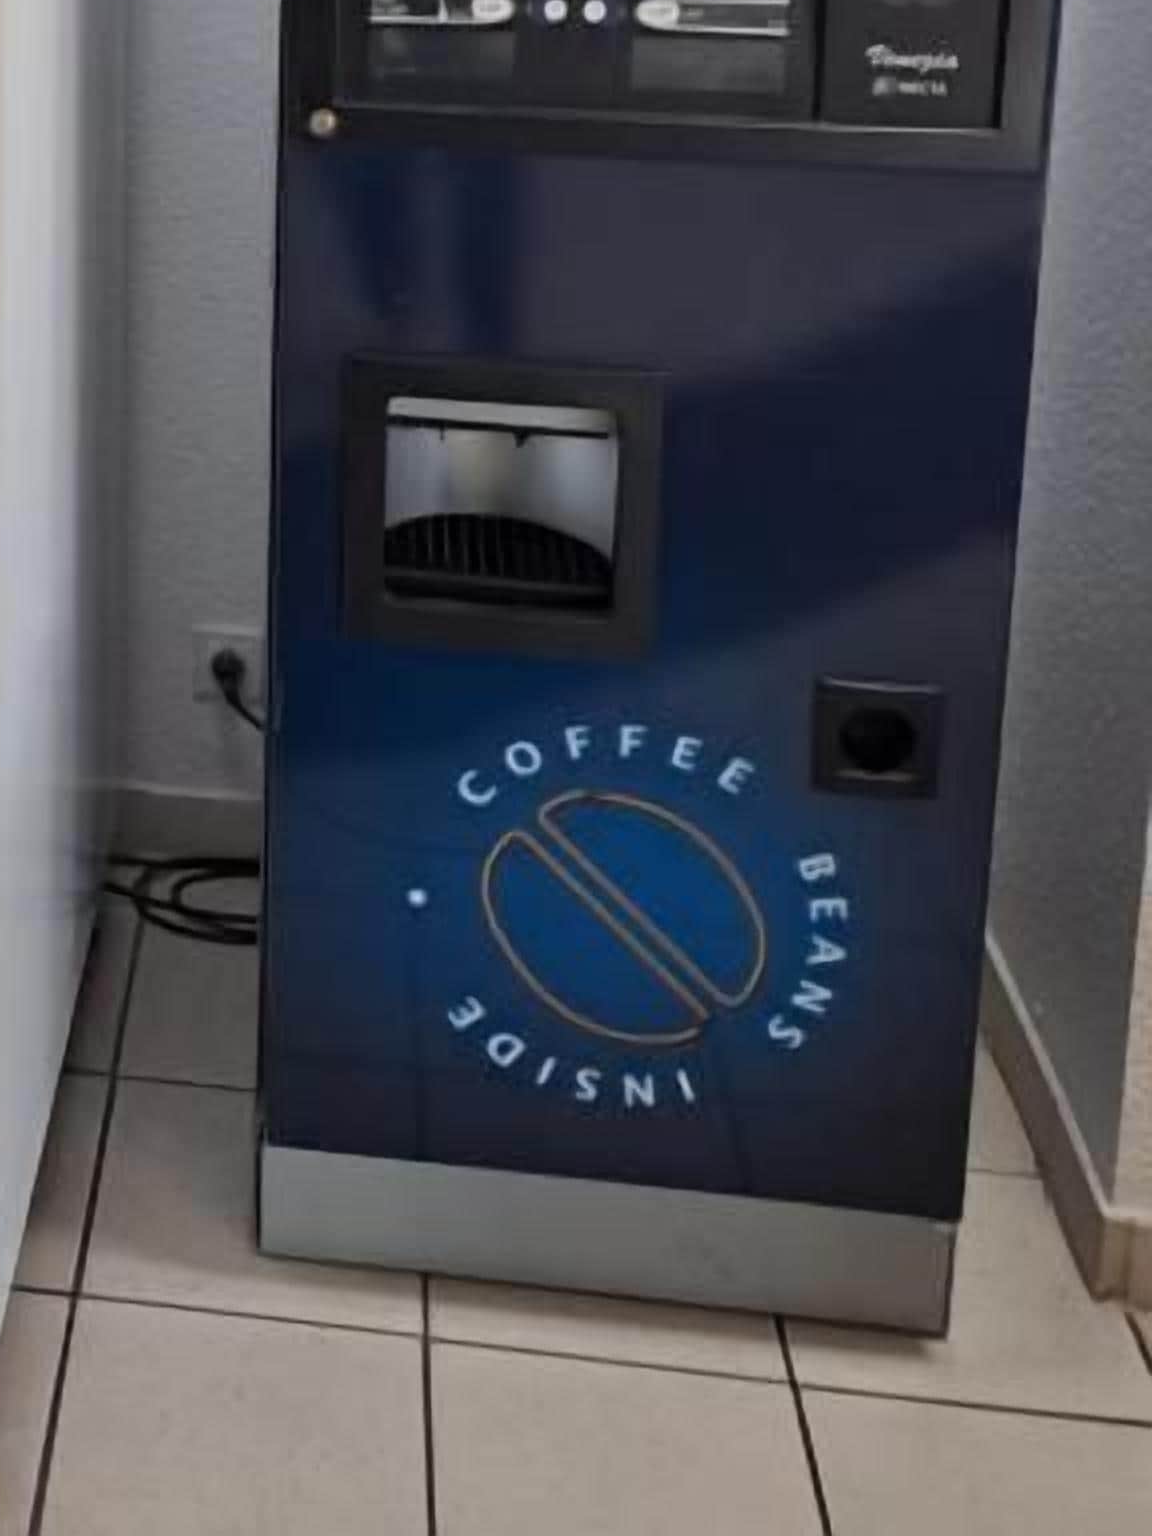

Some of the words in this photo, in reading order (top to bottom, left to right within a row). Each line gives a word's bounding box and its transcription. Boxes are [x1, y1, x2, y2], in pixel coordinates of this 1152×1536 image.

[455, 723, 757, 807] COFFEE
[767, 850, 850, 1051] BEANS
[446, 994, 697, 1109] INSIDE
